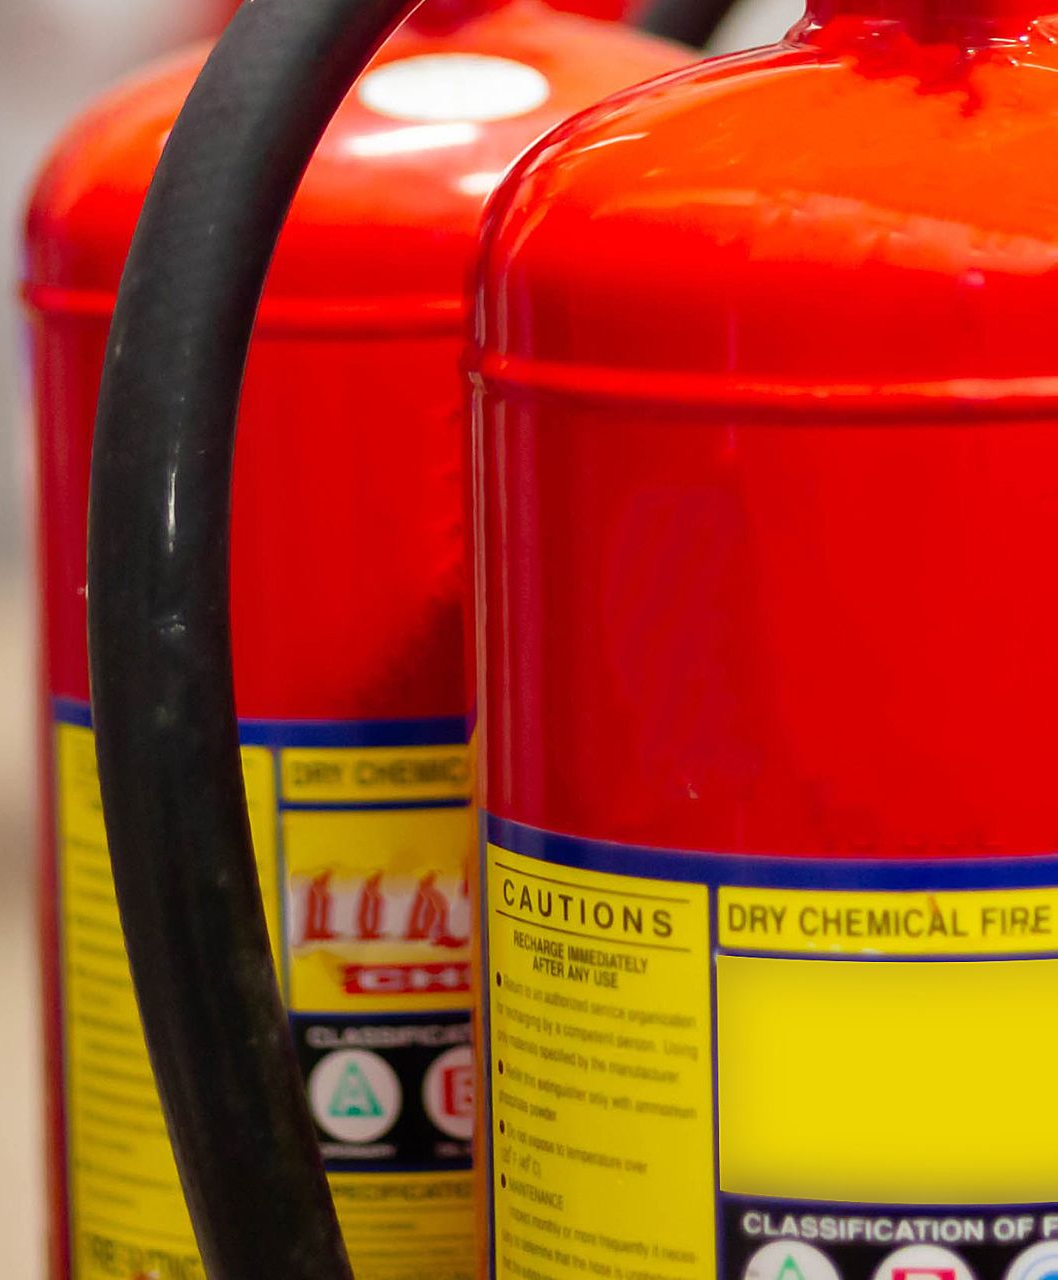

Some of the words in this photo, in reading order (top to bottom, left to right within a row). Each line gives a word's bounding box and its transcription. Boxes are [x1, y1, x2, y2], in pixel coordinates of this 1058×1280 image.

[503, 878, 673, 938] CAUTIONS
[728, 903, 787, 934] DRY
[799, 906, 968, 938] CHEMICAL
[981, 905, 1051, 936] FIRE
[514, 930, 564, 960] RECHARGE
[568, 945, 648, 975] IMMEDIATELY
[533, 956, 564, 977] AFTER
[568, 963, 590, 983] ANY
[593, 970, 618, 989] USE
[743, 1211, 983, 1242] CLASSIFICATION
[993, 1217, 1034, 1241] OF
